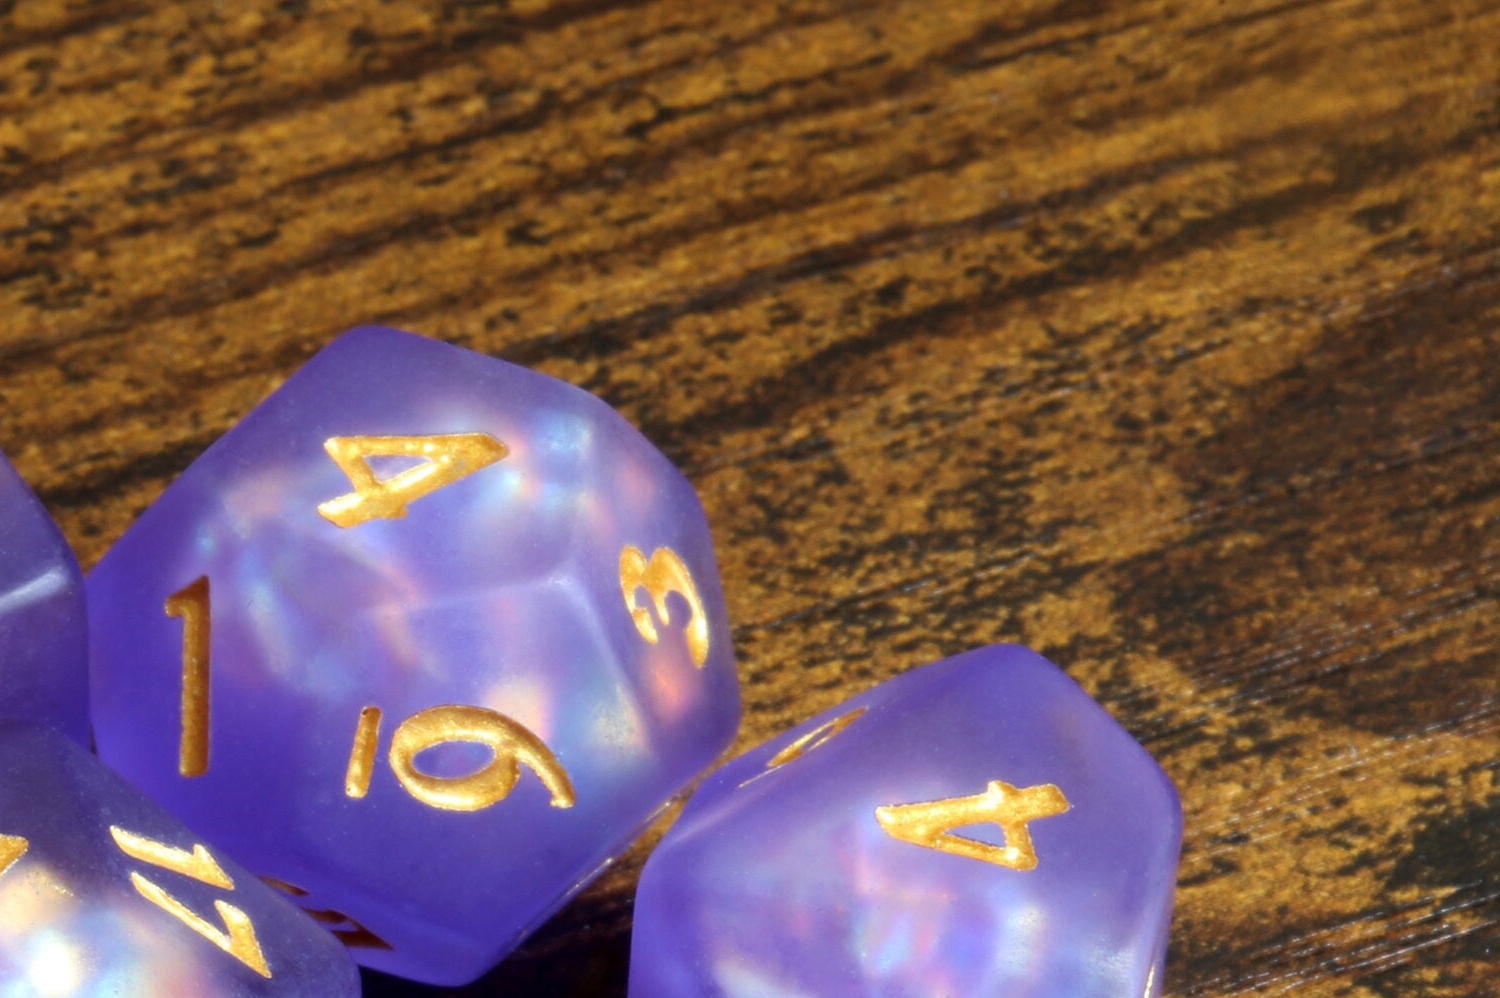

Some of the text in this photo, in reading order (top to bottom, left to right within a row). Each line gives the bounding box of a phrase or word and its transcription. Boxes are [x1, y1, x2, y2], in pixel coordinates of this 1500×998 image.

[317, 432, 509, 528] 4
[619, 545, 709, 669] 3
[164, 574, 211, 777] 1
[875, 780, 1071, 871] 4
